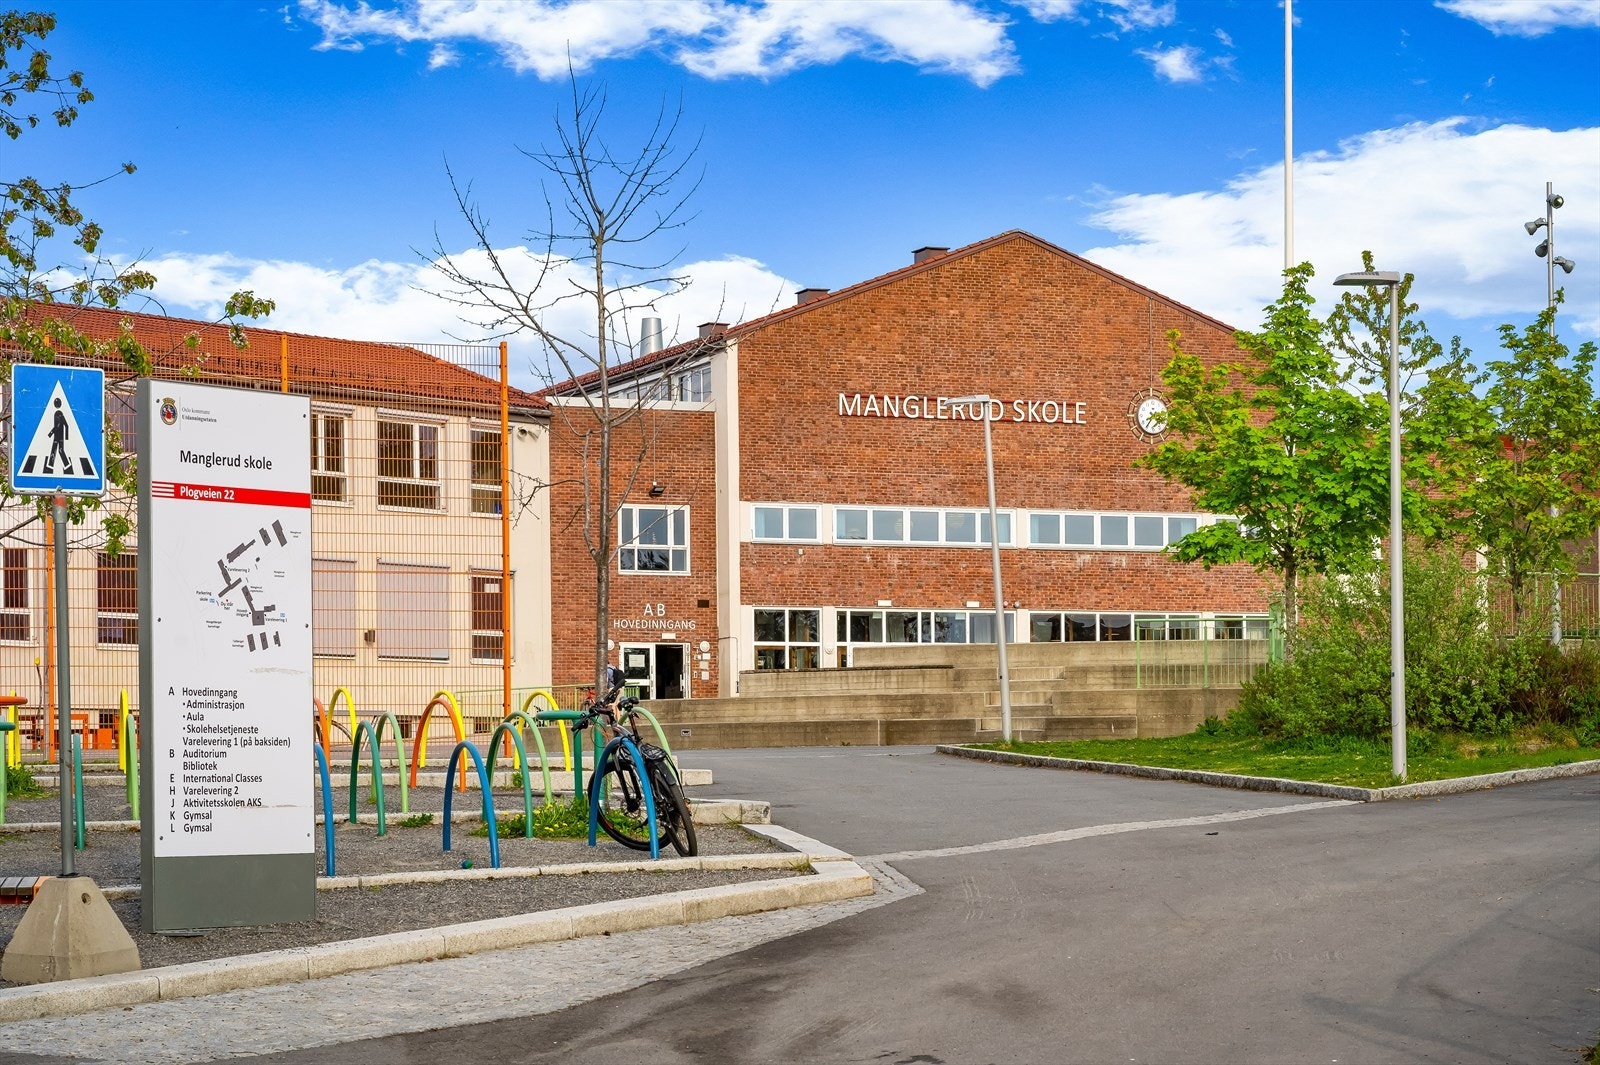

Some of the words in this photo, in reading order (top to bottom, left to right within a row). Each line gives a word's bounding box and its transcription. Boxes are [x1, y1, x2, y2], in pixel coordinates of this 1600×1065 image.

[838, 393, 1003, 421] MANGLERUD
[1013, 400, 1086, 424] SKOLE
[180, 450, 241, 467] Manglerud
[244, 455, 272, 470] skole
[180, 486, 222, 500] Plogveien
[224, 490, 234, 500] 22
[643, 603, 653, 616] A
[658, 604, 665, 616] B
[614, 619, 696, 629] HOVEDINNGANG
[168, 687, 174, 696] A
[182, 688, 238, 699] Hovedinngang
[187, 700, 244, 711] Administrasjon
[187, 712, 204, 721] Aula
[187, 725, 259, 735] Skolehelsetjeneste
[183, 737, 232, 748] Varelevering
[234, 738, 238, 746] 1
[241, 737, 252, 748] (på
[255, 737, 291, 747] baksiden)
[170, 749, 174, 758] B
[183, 749, 226, 758] Auditorium
[183, 762, 218, 770] Bibliotek
[170, 774, 174, 782] E
[183, 774, 233, 782] International
[236, 774, 262, 782] Classes
[170, 787, 175, 795] H
[183, 786, 232, 796] Varelevering
[234, 786, 238, 795] 2
[171, 799, 175, 807] J
[183, 799, 245, 807] Aktivitetsskolen
[247, 798, 262, 806] AKS
[170, 812, 175, 820] K
[184, 811, 212, 822] Gymsal
[171, 824, 175, 832] L
[184, 823, 212, 834] Gymsal
